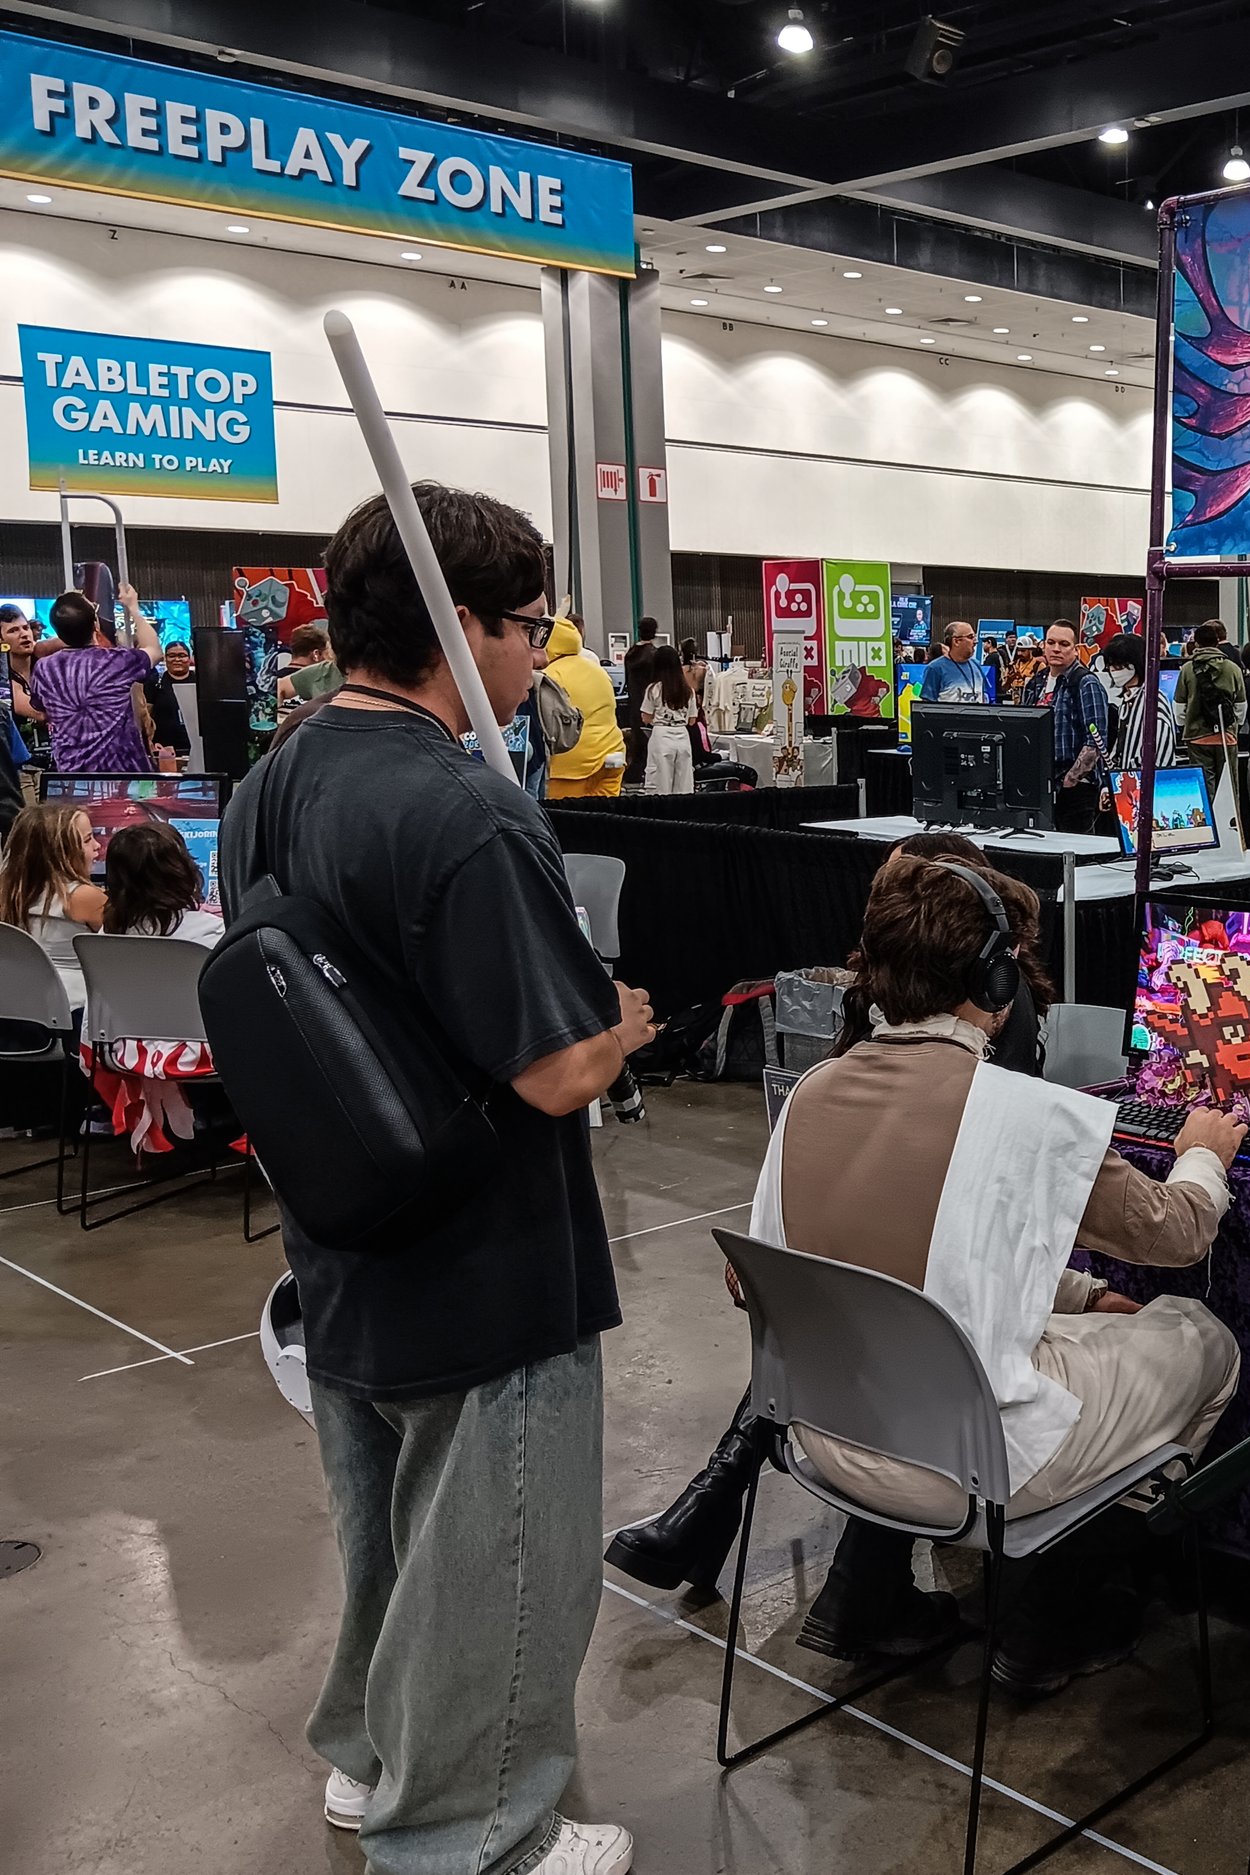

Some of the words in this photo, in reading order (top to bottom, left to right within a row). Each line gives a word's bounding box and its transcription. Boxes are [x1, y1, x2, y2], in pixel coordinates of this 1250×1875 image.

[30, 73, 371, 187] FREEPLAY
[397, 146, 564, 226] ZONE
[36, 352, 258, 405] TABLETOP
[52, 395, 251, 444] GAMING
[77, 449, 145, 468] LEARN
[151, 453, 179, 471] TO
[185, 456, 233, 474] PLAY
